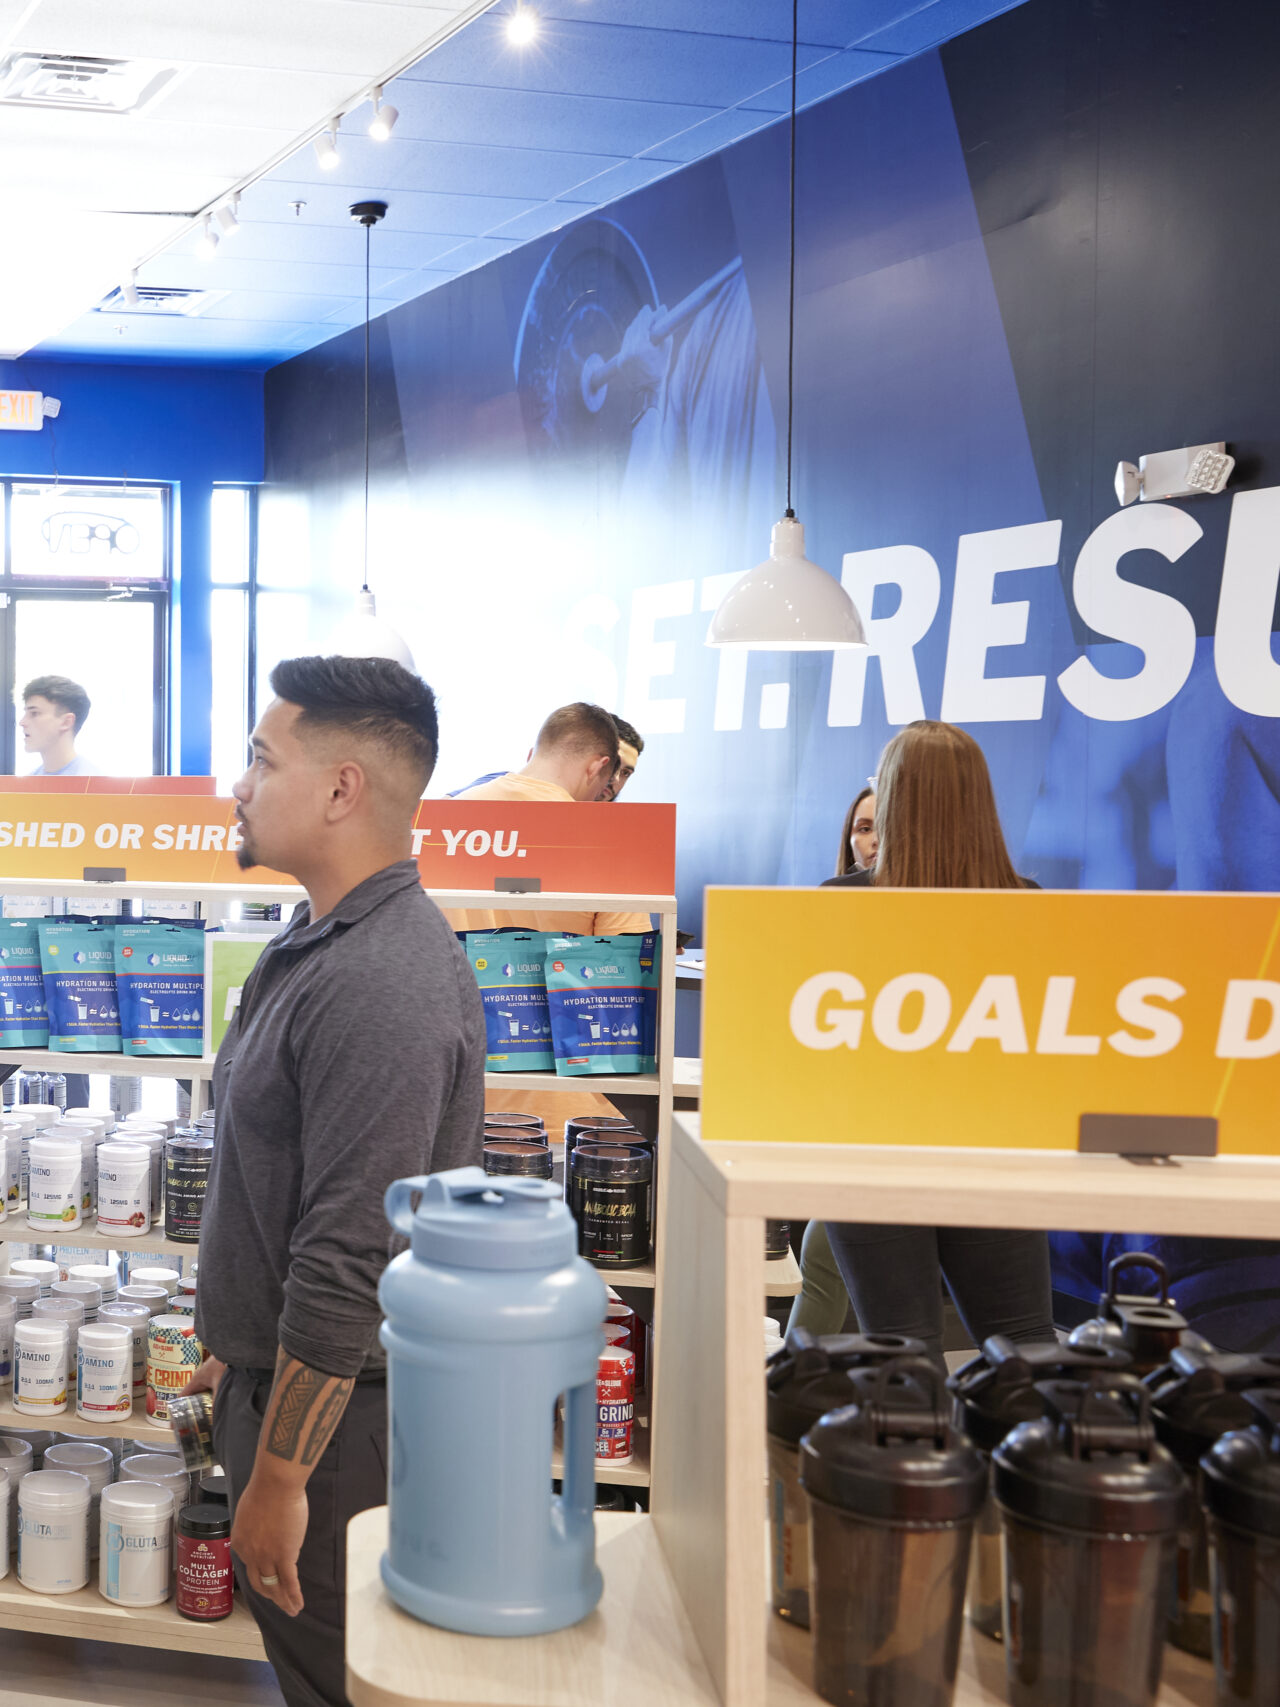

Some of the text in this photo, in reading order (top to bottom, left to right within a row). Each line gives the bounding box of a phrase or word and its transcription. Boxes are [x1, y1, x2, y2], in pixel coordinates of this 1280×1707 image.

[93, 823, 145, 850] OR
[442, 830, 528, 858] YOU.
[11, 947, 35, 956] LIQUID
[88, 951, 112, 960] LIQUID
[517, 964, 541, 972] LIQUID
[56, 980, 97, 988] HYDRATION
[130, 982, 170, 990] HYDRATION
[484, 995, 528, 1003] HYDRATION
[563, 997, 608, 1006] HYDRATION
[788, 970, 1187, 1058] GOALS
[21, 1351, 50, 1362] AMINO
[84, 1358, 114, 1368] AMINO
[599, 1403, 634, 1422] GRIND
[125, 1536, 158, 1549] GLUTA
[190, 1562, 216, 1571] MULTI
[179, 1564, 229, 1579] COLLAGEN
[186, 1577, 220, 1585] PROTEIN
